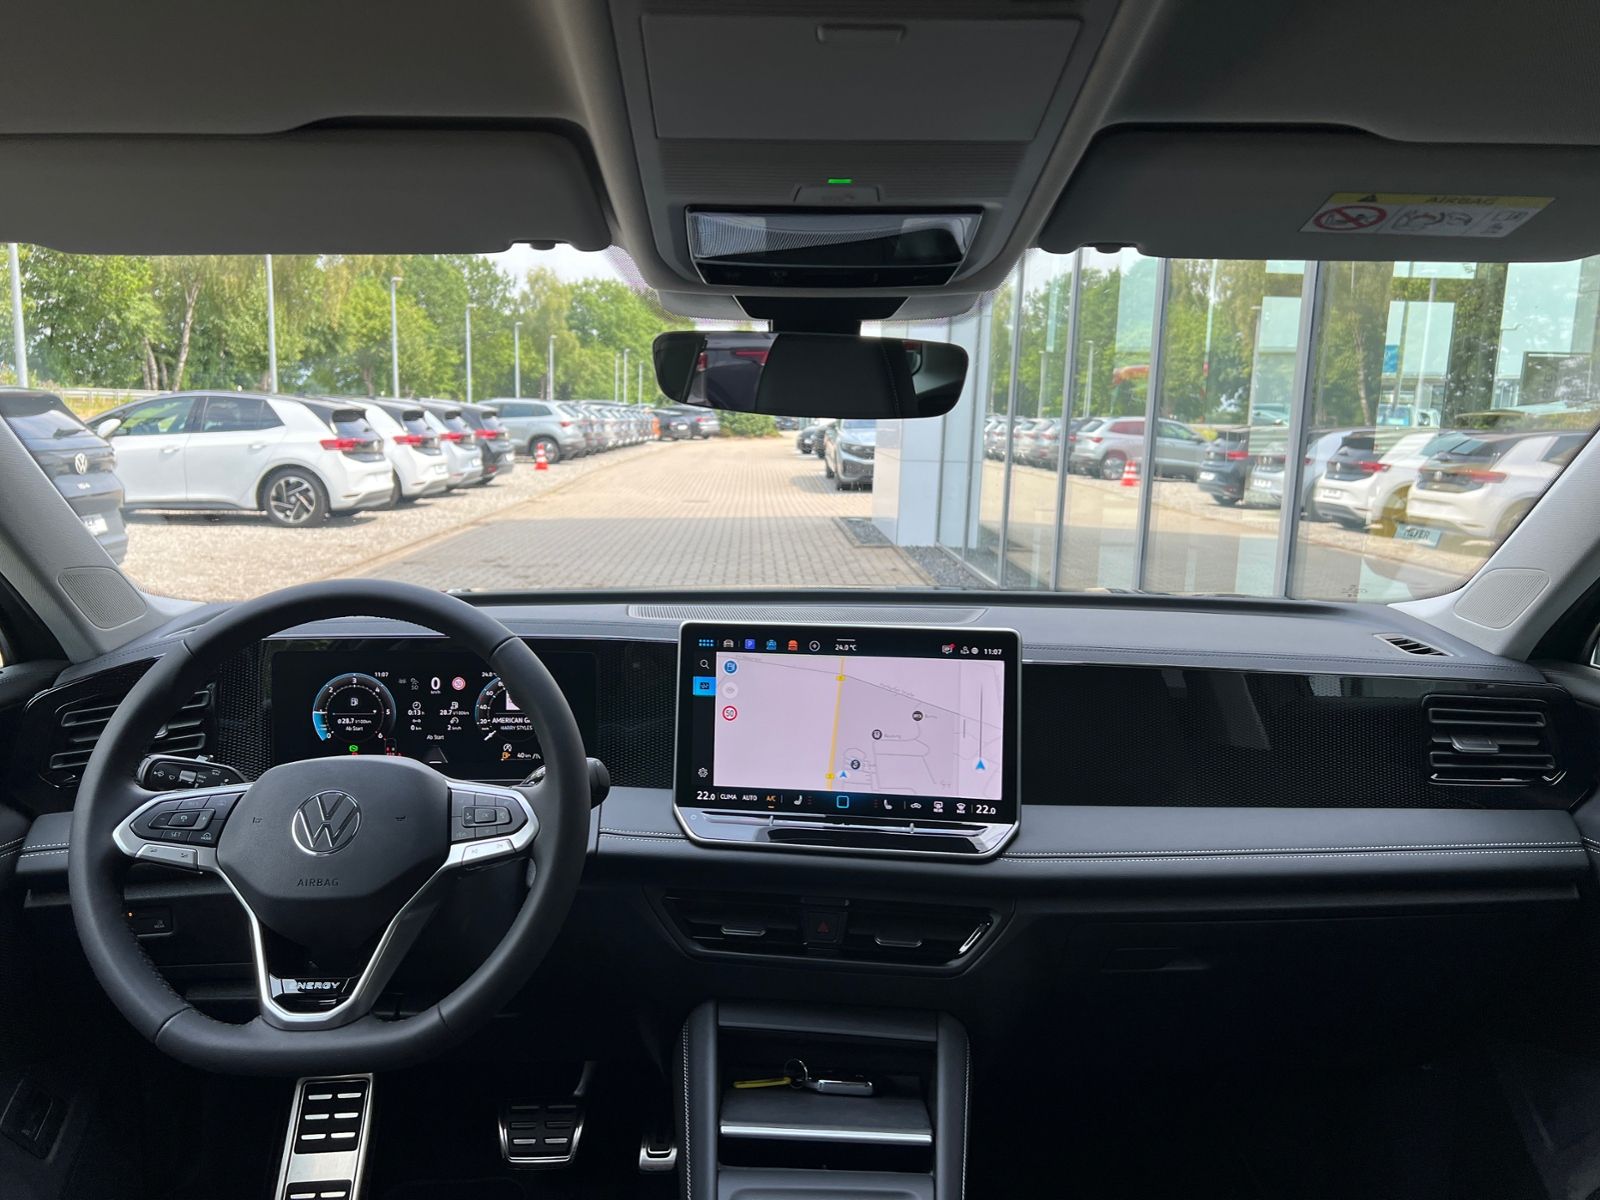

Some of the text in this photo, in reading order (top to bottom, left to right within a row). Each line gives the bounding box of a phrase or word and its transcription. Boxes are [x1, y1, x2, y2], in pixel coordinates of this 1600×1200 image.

[1426, 196, 1495, 206] AIRBAG
[431, 677, 440, 690] 0
[726, 709, 735, 718] 50
[696, 790, 716, 800] 22.0
[976, 804, 997, 814] 22.0
[297, 879, 339, 887] AIRBAG
